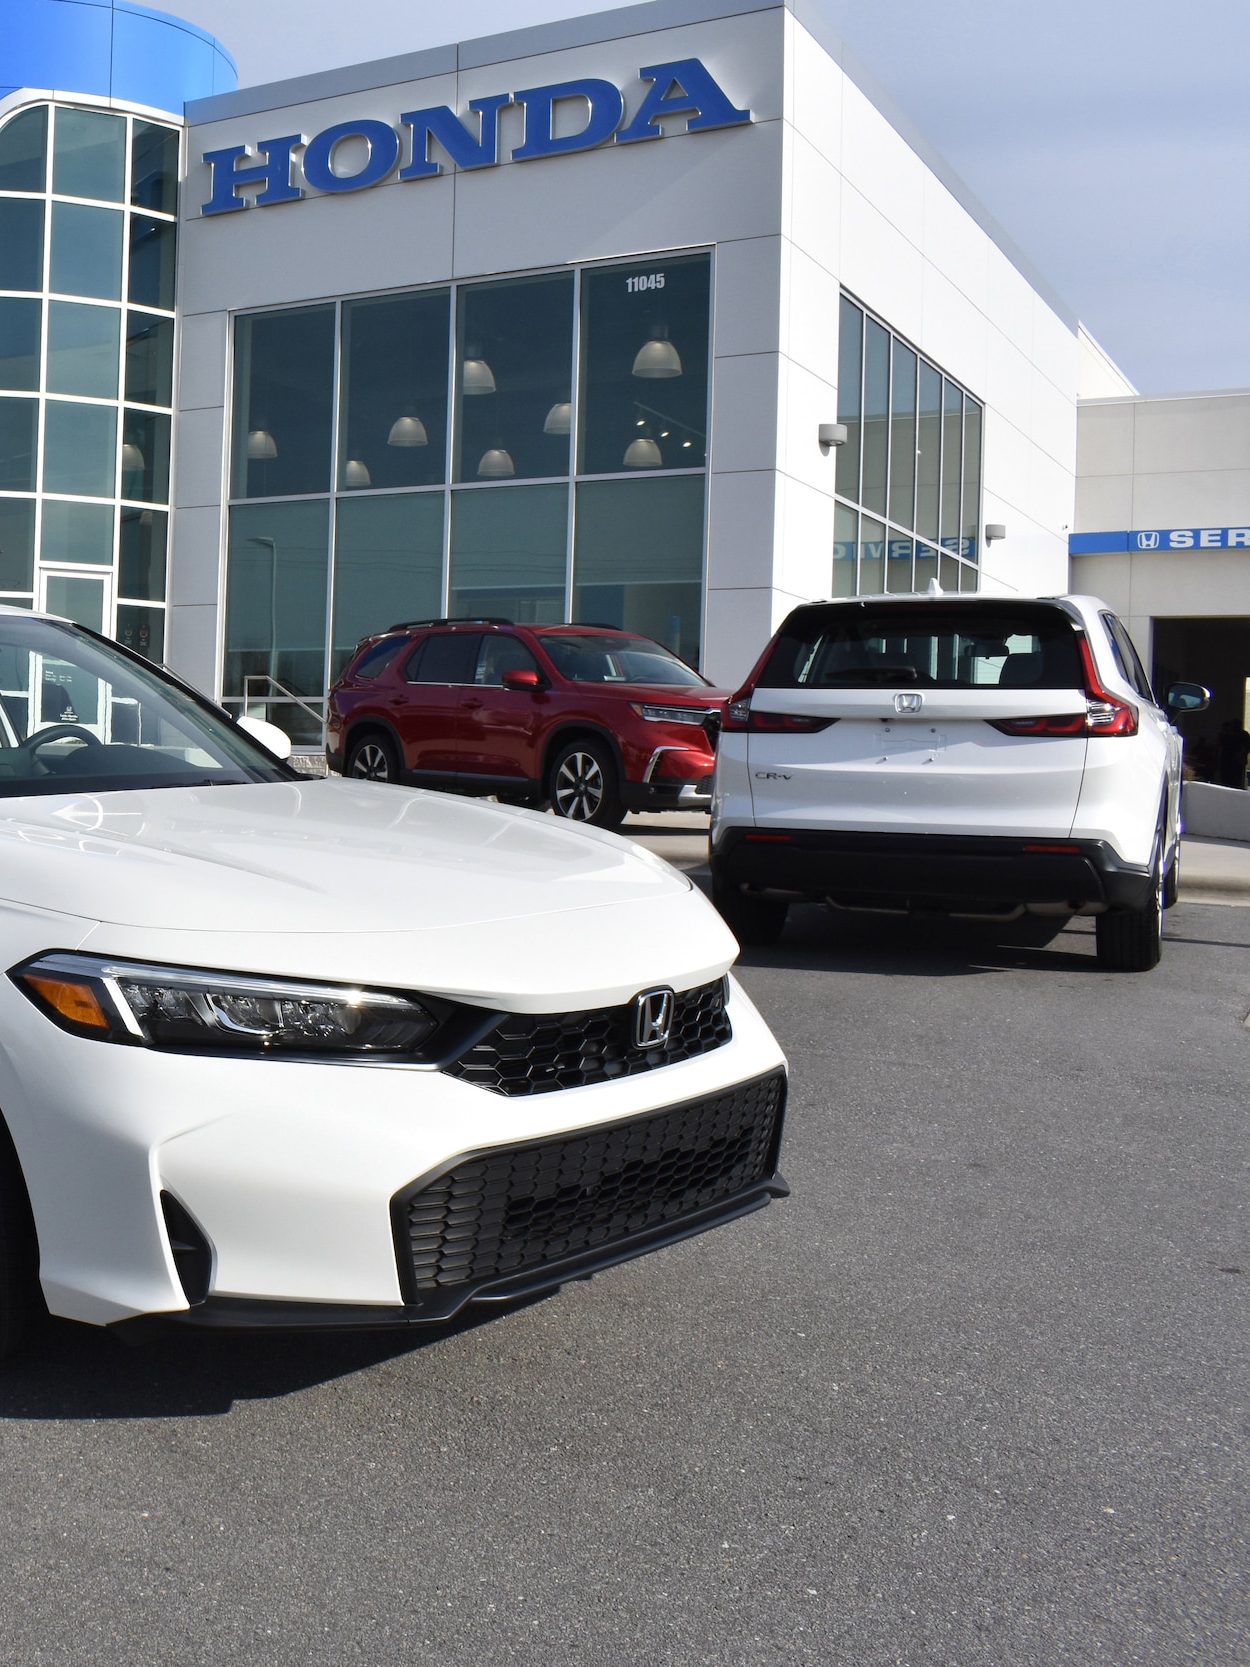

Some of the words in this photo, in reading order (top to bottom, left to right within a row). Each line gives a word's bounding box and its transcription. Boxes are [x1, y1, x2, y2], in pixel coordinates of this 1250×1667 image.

[201, 57, 753, 216] HONDA
[626, 272, 666, 293] 11045
[755, 771, 793, 780] CR-V
